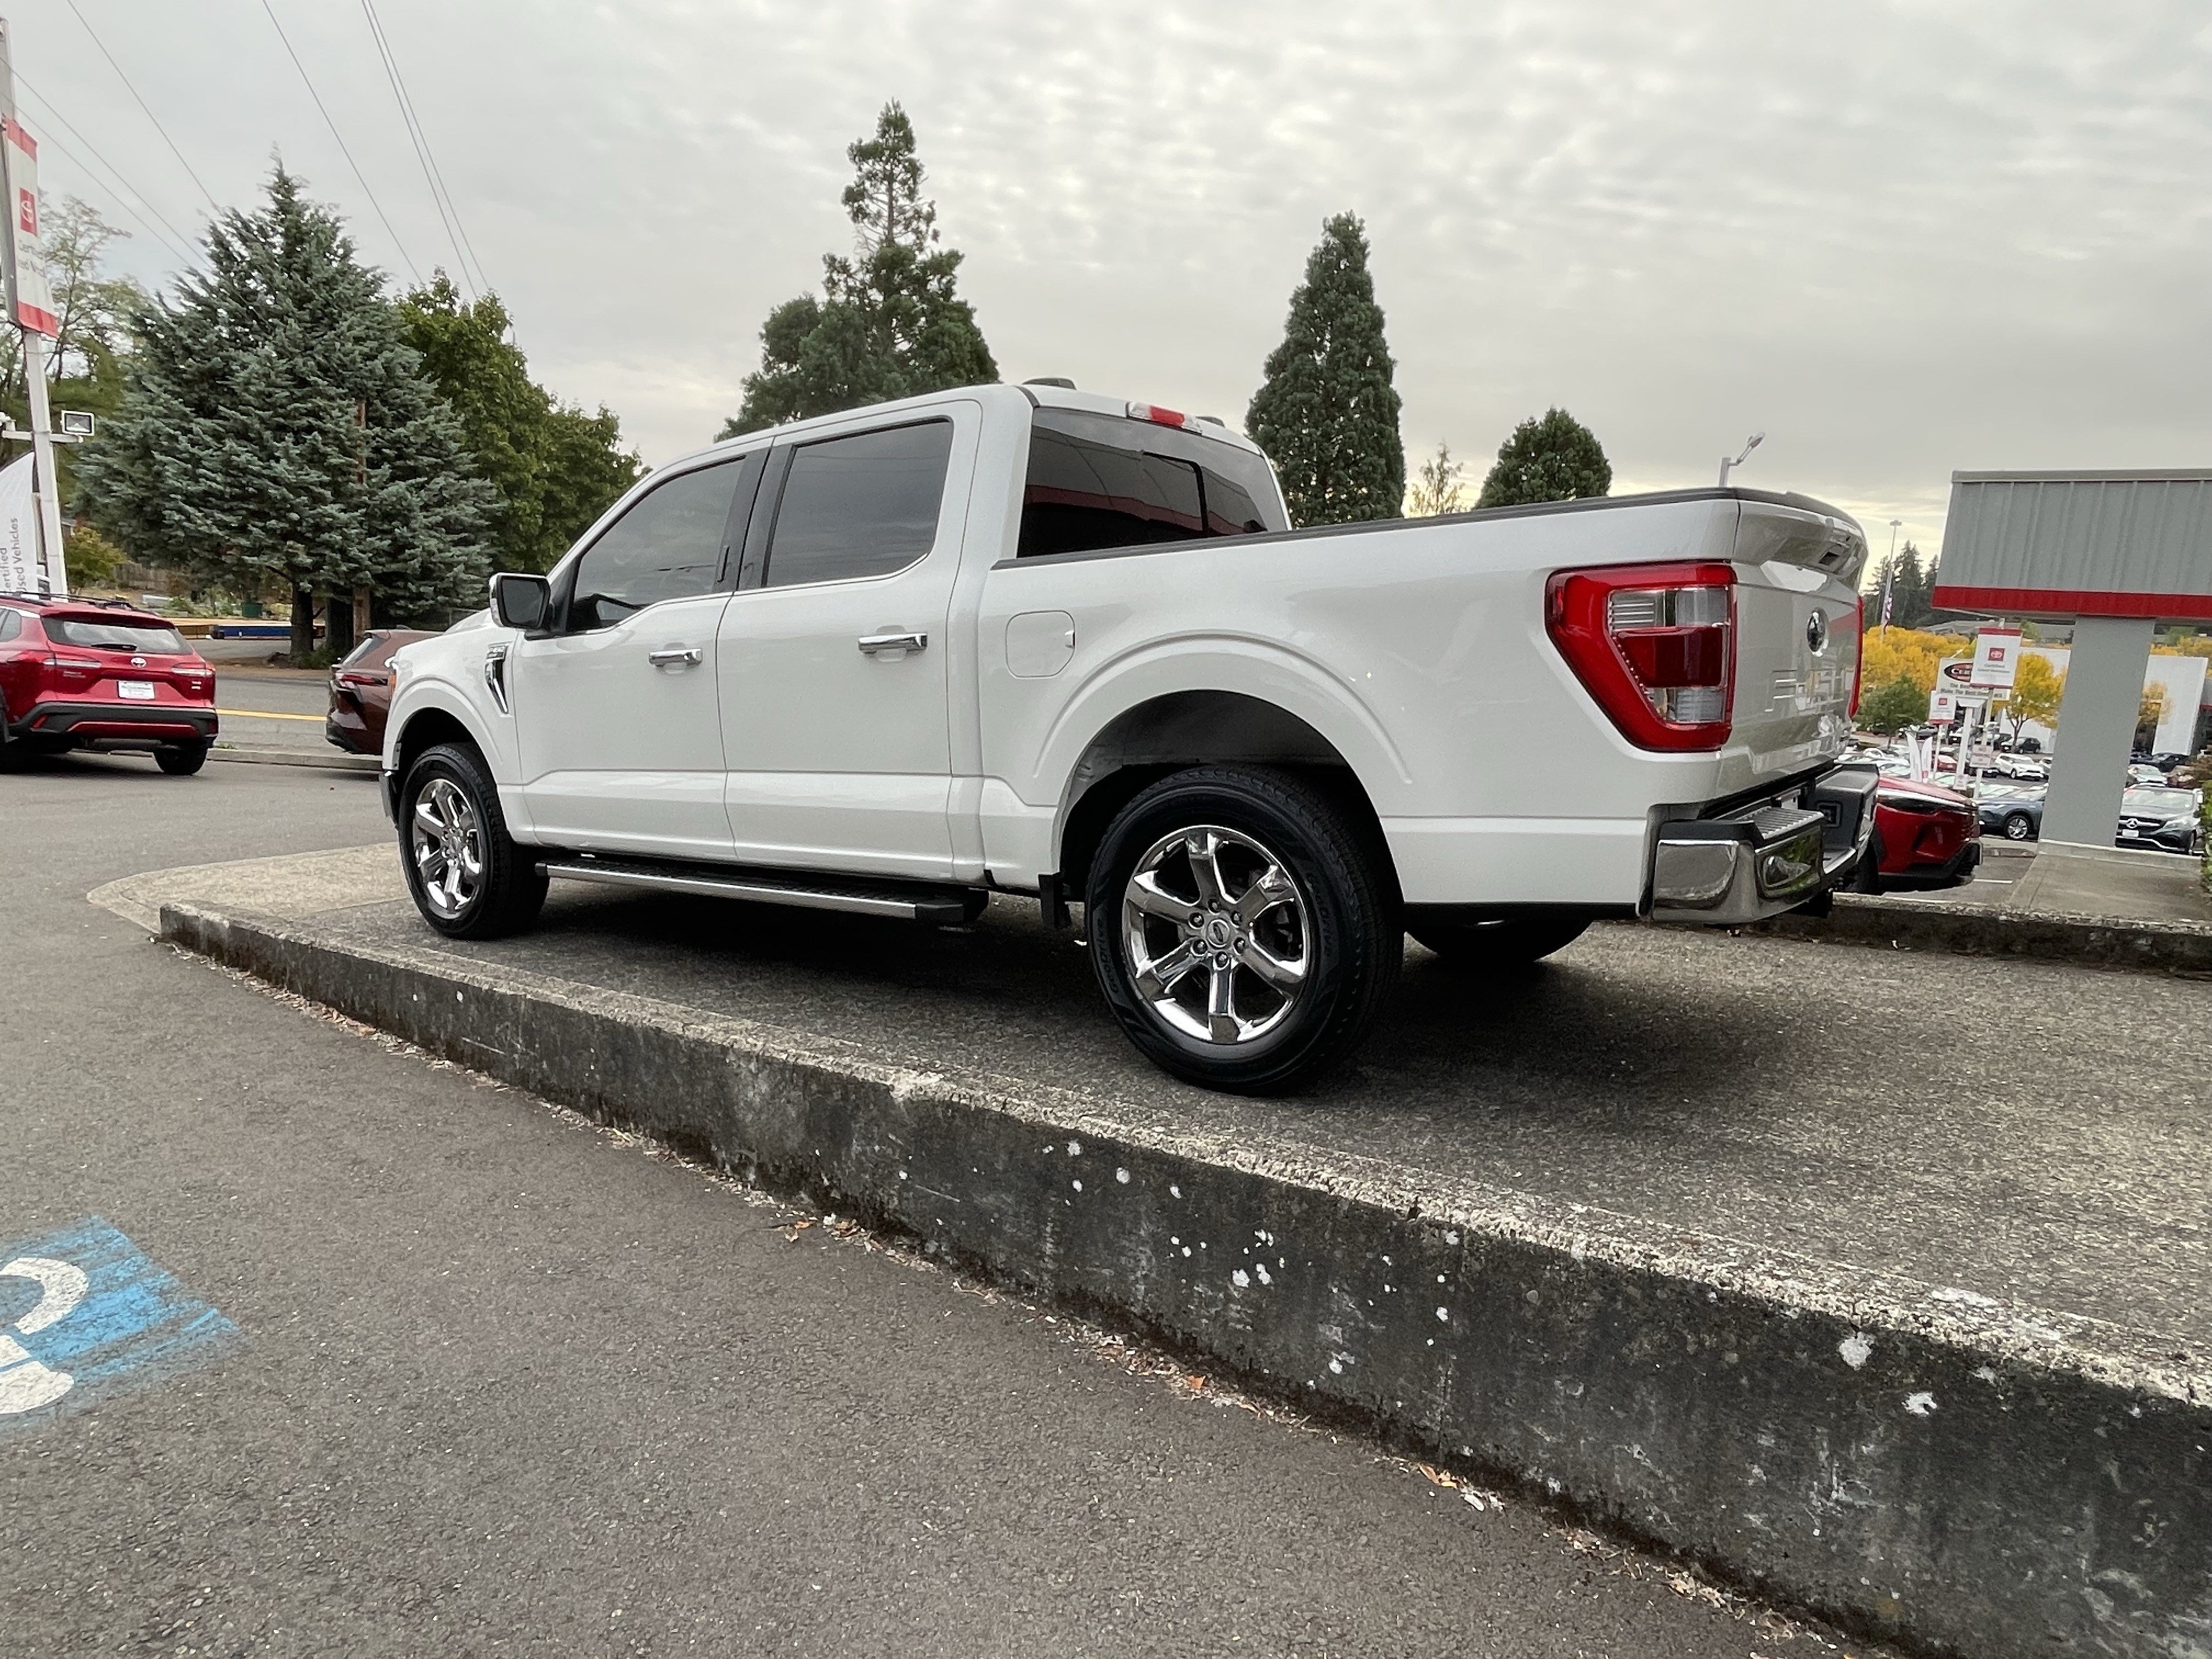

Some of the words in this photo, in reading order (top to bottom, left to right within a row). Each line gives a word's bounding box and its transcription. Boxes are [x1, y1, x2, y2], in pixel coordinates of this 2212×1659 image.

[9, 517, 22, 564] Vehicles
[0, 548, 11, 592] ertified
[1097, 918, 1119, 993] GeoDrive
